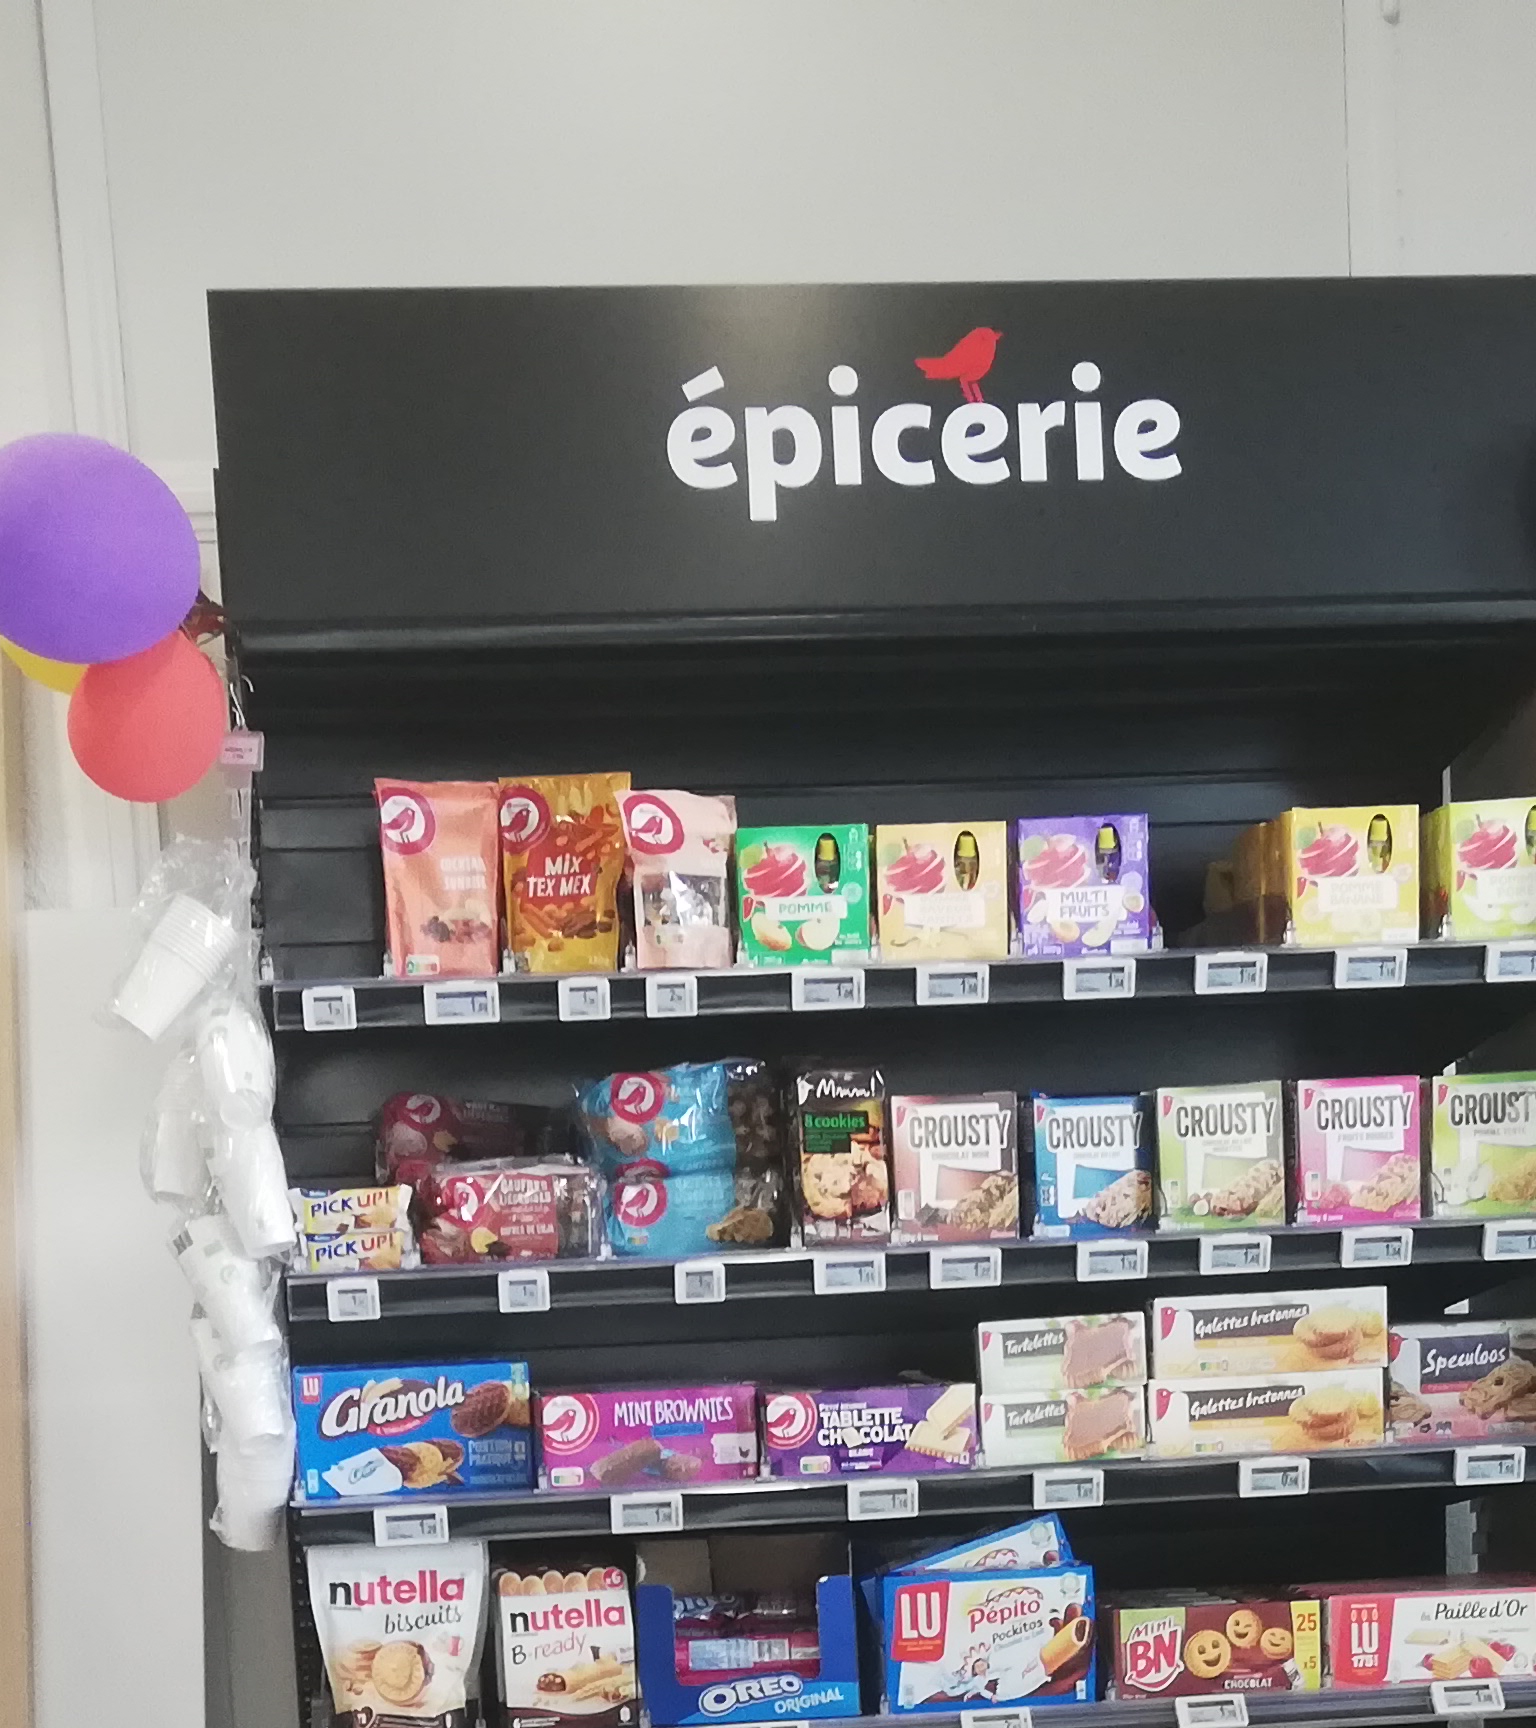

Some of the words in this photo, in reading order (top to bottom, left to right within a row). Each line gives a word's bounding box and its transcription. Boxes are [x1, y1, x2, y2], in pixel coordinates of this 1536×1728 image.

[667, 365, 1182, 521] épicerie
[526, 875, 555, 899] TEX
[559, 873, 593, 898] MEX
[1059, 890, 1110, 905] MULTI
[777, 900, 834, 917] POMME
[1058, 903, 1112, 919] FRUITS
[814, 1114, 866, 1130] cookies
[1175, 1102, 1278, 1138] CROUSTY
[1316, 1094, 1412, 1131] CROUSTY
[908, 1110, 1010, 1149] CROUSTY
[1048, 1112, 1142, 1150] CROUSTY
[356, 1190, 391, 1214] UP!
[1195, 1315, 1249, 1338] Galettes
[1250, 1304, 1310, 1329] bretonnes
[1005, 1333, 1065, 1355] Tartelettes
[1422, 1343, 1507, 1377] Speculoos
[321, 1376, 465, 1439] Granola
[613, 1399, 653, 1427] MINI
[655, 1396, 734, 1425] BROWNIES
[820, 1407, 903, 1428] TABLETTE
[1006, 1403, 1066, 1428] Tartelettes
[1190, 1398, 1244, 1420] Galettes
[1245, 1386, 1304, 1411] bretonnes
[329, 1570, 466, 1606] nutella
[384, 1605, 464, 1634] biscuits
[509, 1598, 627, 1634] nutella
[899, 1590, 941, 1640] LU
[968, 1598, 1041, 1634] Pépito
[1295, 1612, 1318, 1632] 25
[1434, 1601, 1488, 1622] Paille
[1489, 1598, 1528, 1620] d'Or
[990, 1618, 1045, 1644] Pockitos
[1350, 1622, 1379, 1656] LU
[511, 1632, 587, 1665] B-ready
[1129, 1635, 1181, 1677] BN
[1302, 1656, 1318, 1672] x5
[702, 1676, 801, 1714] OREO
[1224, 1676, 1272, 1690] CHOCOLAT
[774, 1686, 845, 1715] ORIGINAL
